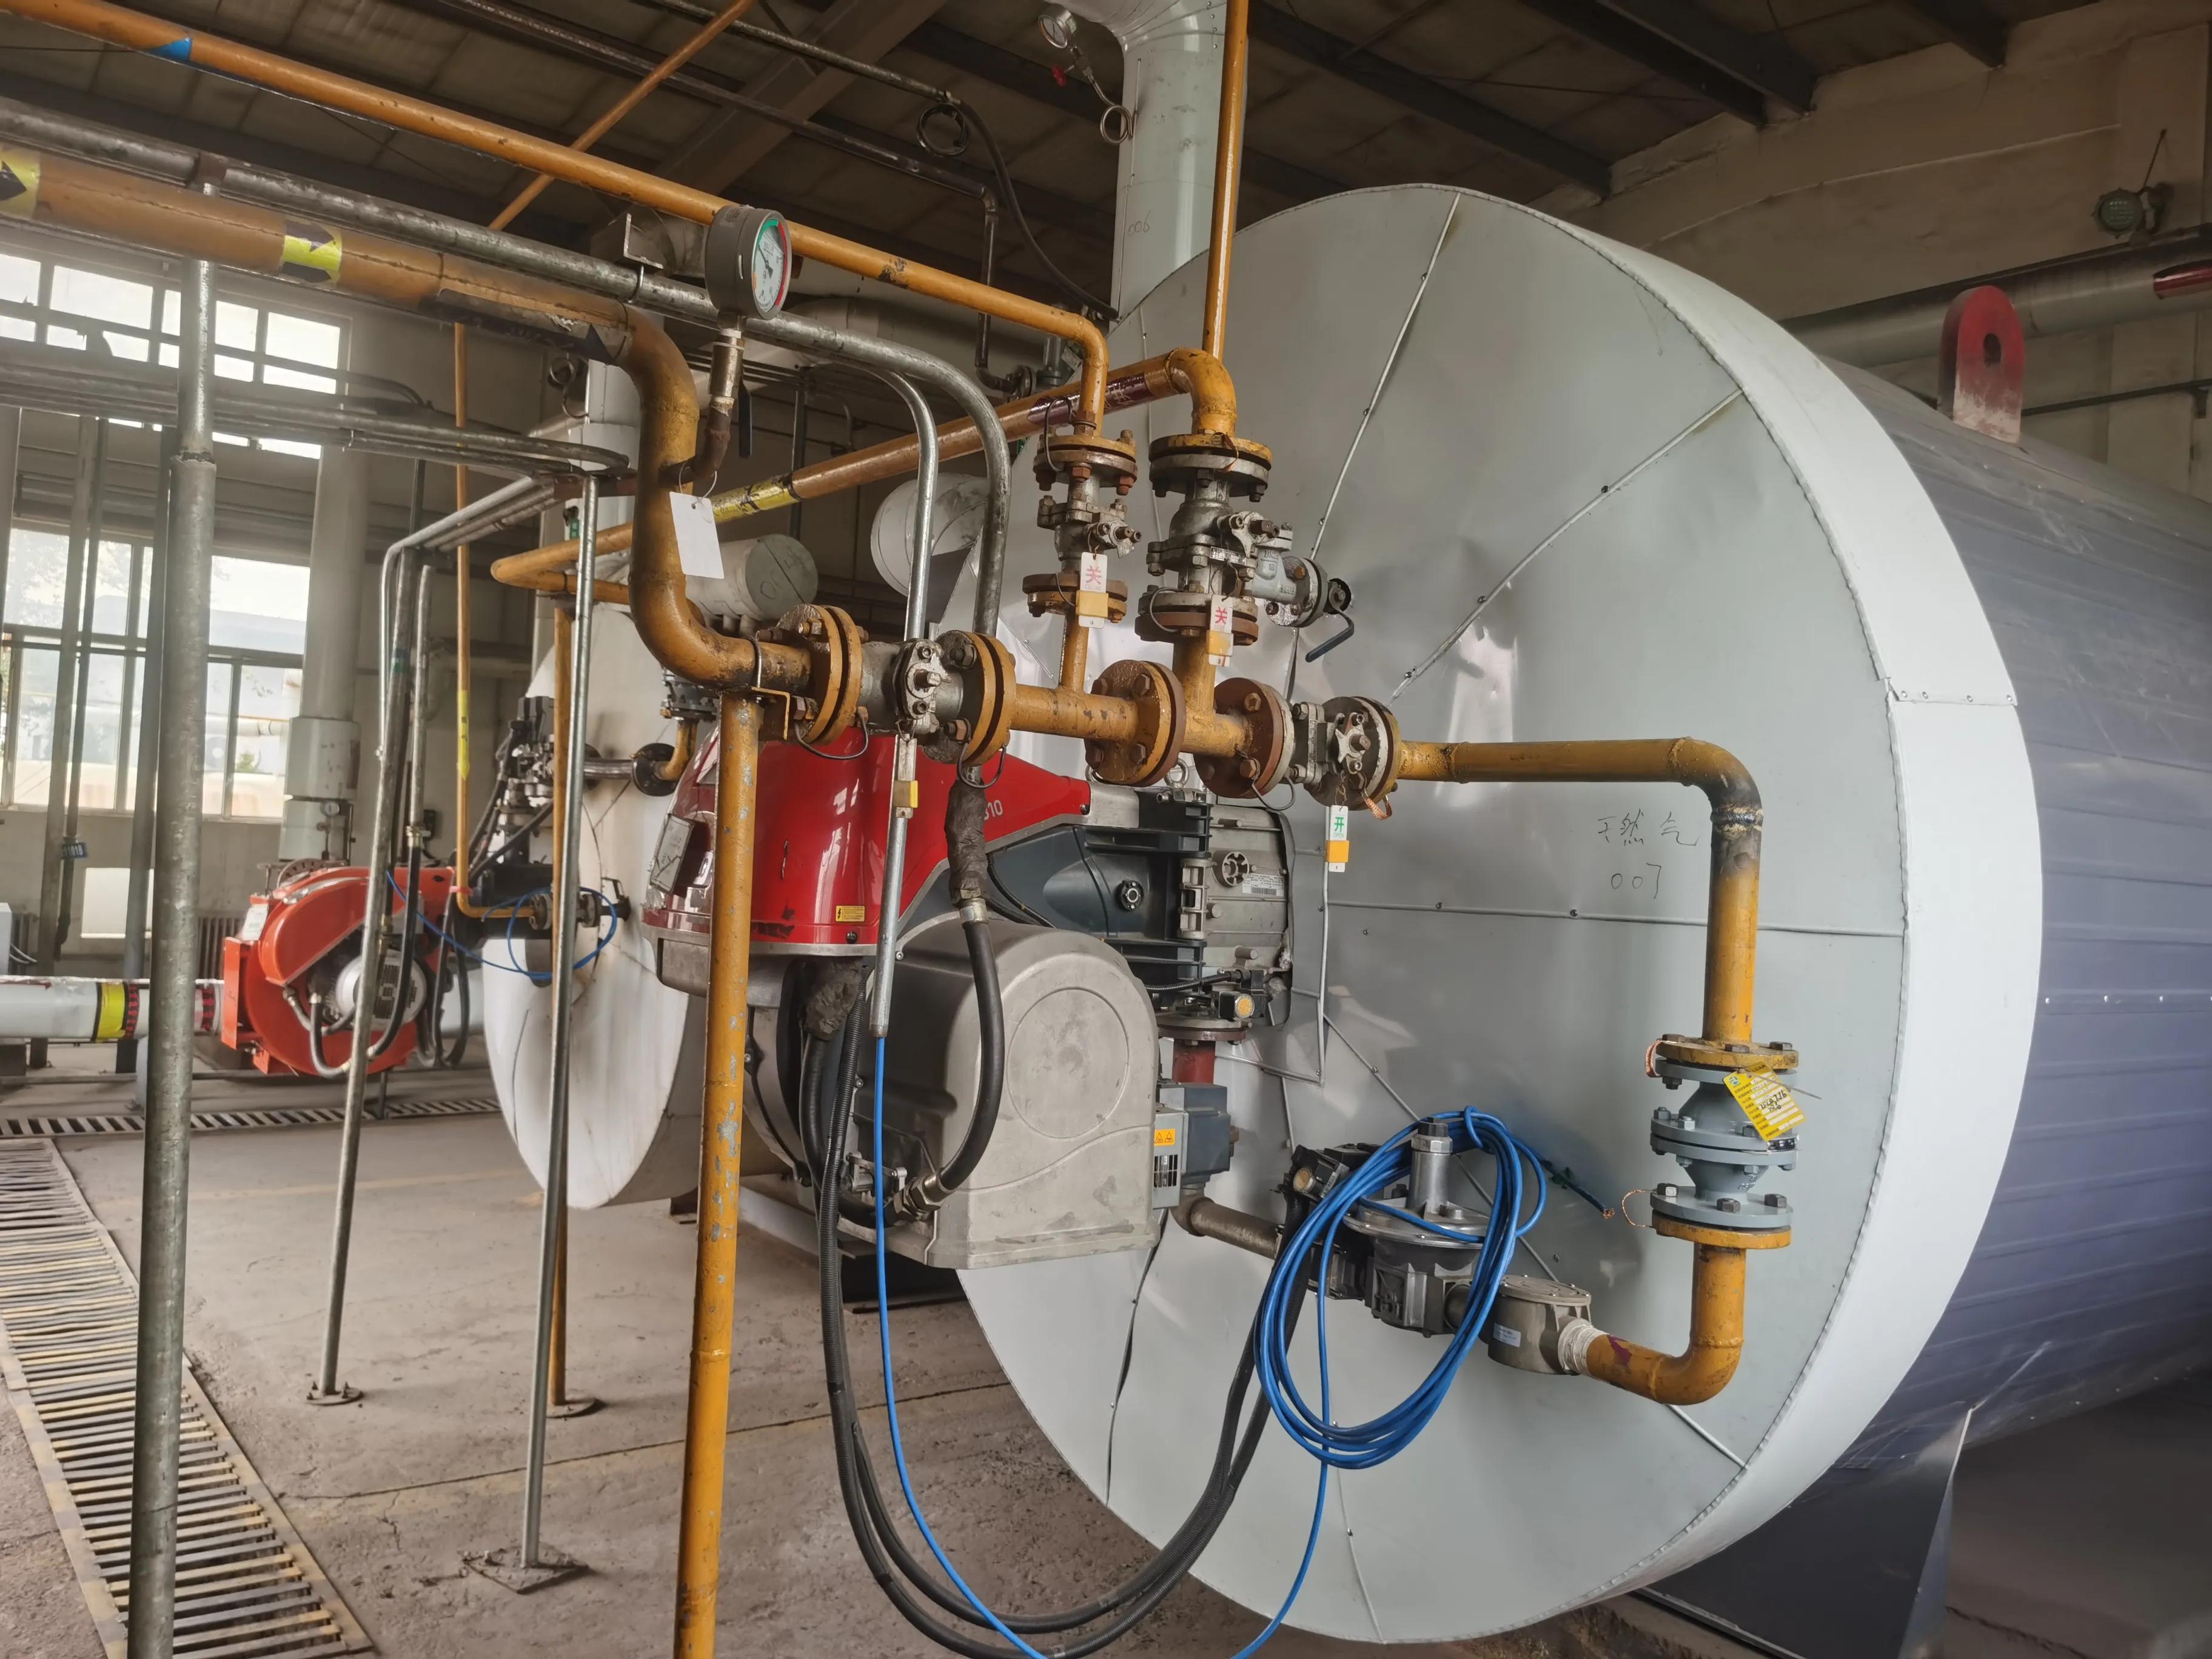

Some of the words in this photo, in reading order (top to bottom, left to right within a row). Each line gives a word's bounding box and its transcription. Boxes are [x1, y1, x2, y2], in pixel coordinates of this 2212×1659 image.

[1128, 209, 1151, 237] 006
[1085, 565, 1102, 586] 关
[1215, 606, 1228, 626] 关
[1334, 817, 1344, 833] 开
[1610, 862, 1662, 899] 007
